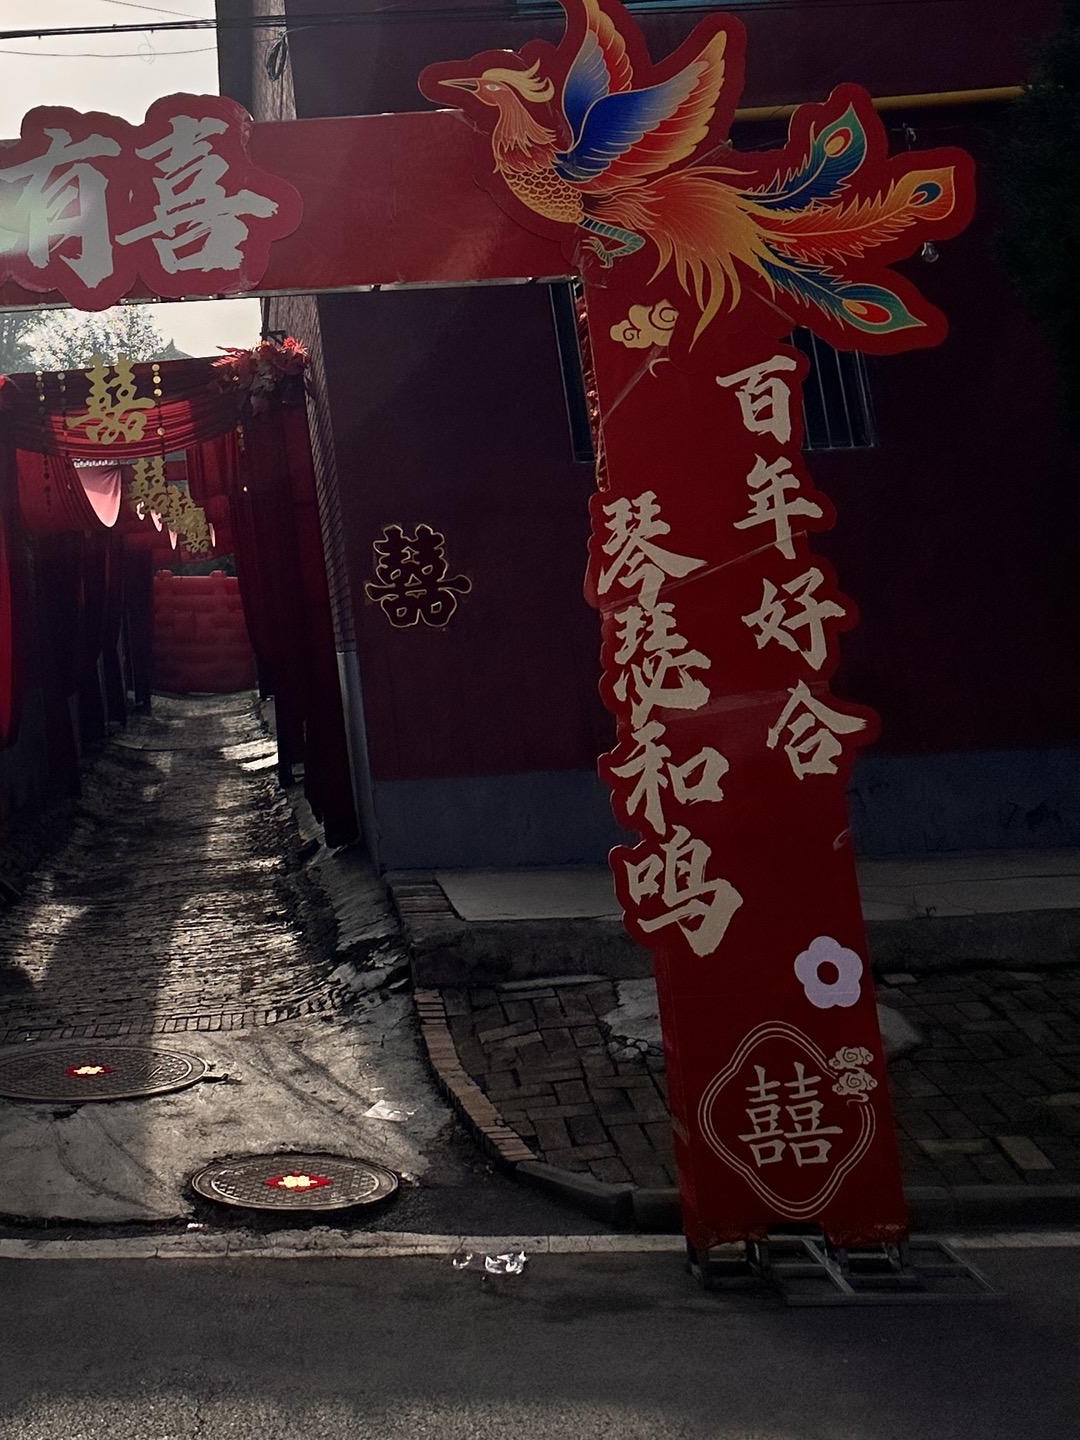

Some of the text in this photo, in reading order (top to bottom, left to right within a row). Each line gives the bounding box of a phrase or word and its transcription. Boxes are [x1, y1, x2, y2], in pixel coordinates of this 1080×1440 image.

[599, 490, 744, 957] 琴瑟和鸣
[717, 355, 867, 779] 百年好合
[739, 1063, 843, 1168] 囍
